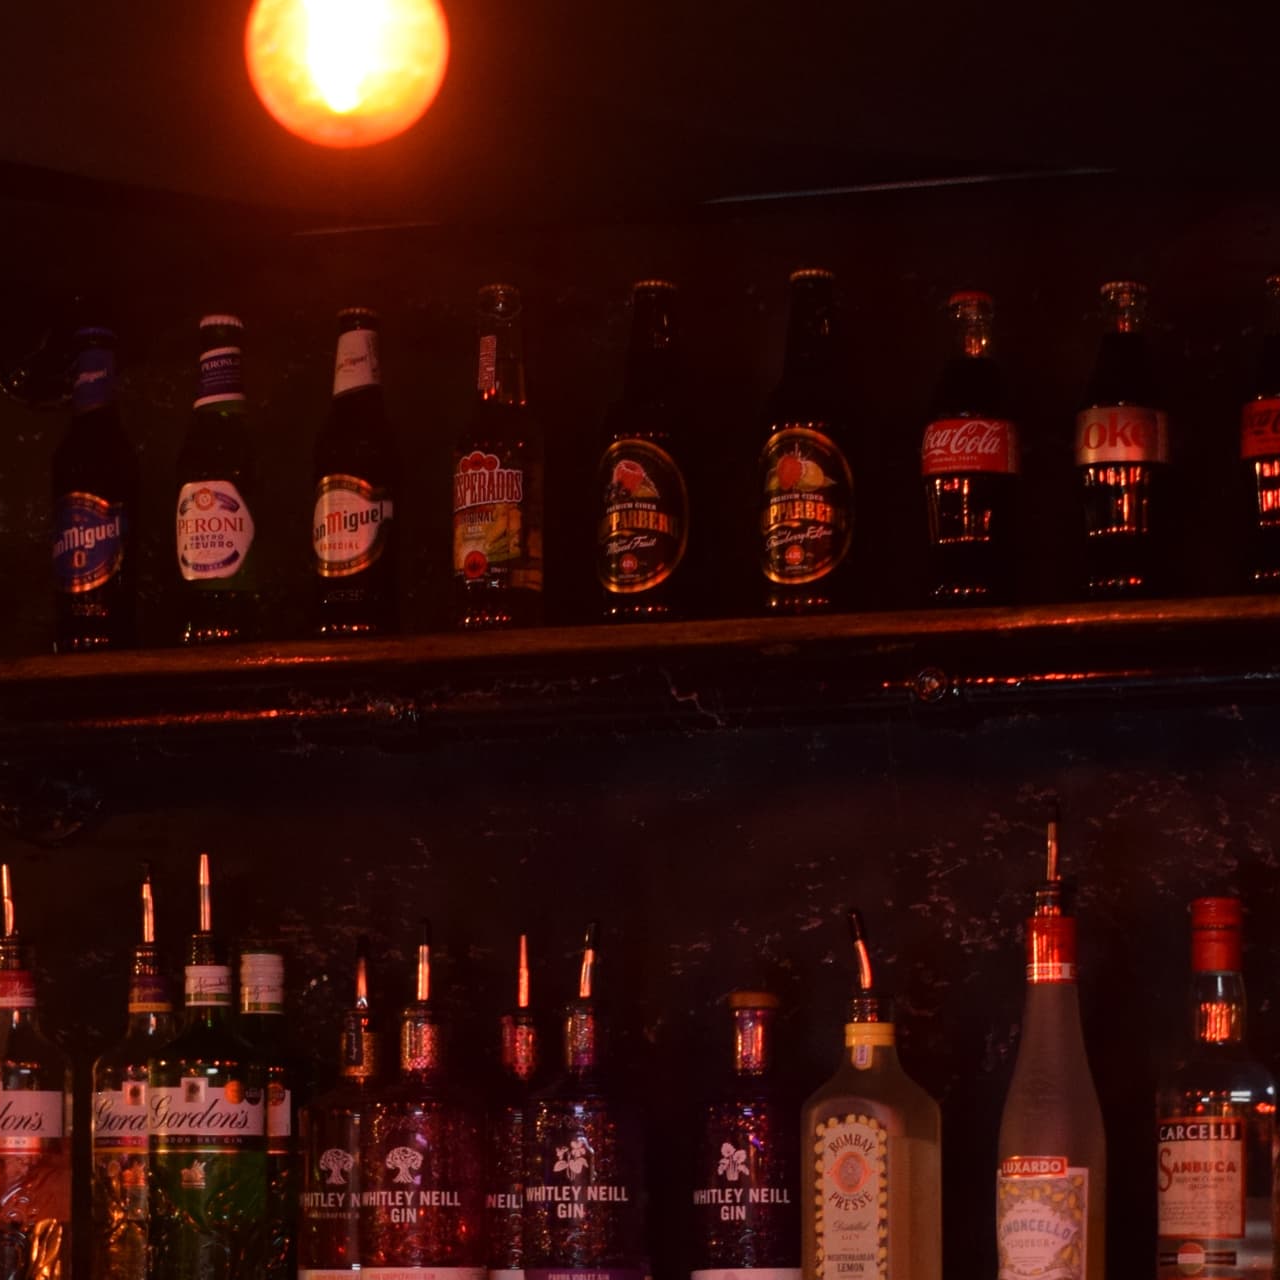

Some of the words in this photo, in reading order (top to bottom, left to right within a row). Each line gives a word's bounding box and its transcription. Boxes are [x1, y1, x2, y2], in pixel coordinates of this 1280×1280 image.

[1083, 402, 1152, 450] oke
[178, 516, 244, 536] PERONI
[327, 503, 384, 533] Miguel
[63, 516, 121, 552] Miguel
[150, 1095, 250, 1132] Gordon's
[828, 1133, 876, 1156] BOMBAY
[1003, 1160, 1062, 1175] LUXARDO
[1159, 1147, 1237, 1193] SAMBUCA
[420, 1190, 462, 1206] NEILL
[525, 1185, 582, 1202] WHITLEY
[587, 1185, 629, 1202] NEILL
[693, 1187, 744, 1206] WHITLEY
[748, 1187, 792, 1204] NEILL
[390, 1207, 418, 1224] GIN
[556, 1203, 585, 1220] GIN
[720, 1205, 747, 1221] GIN
[837, 1262, 865, 1274] LEMON
